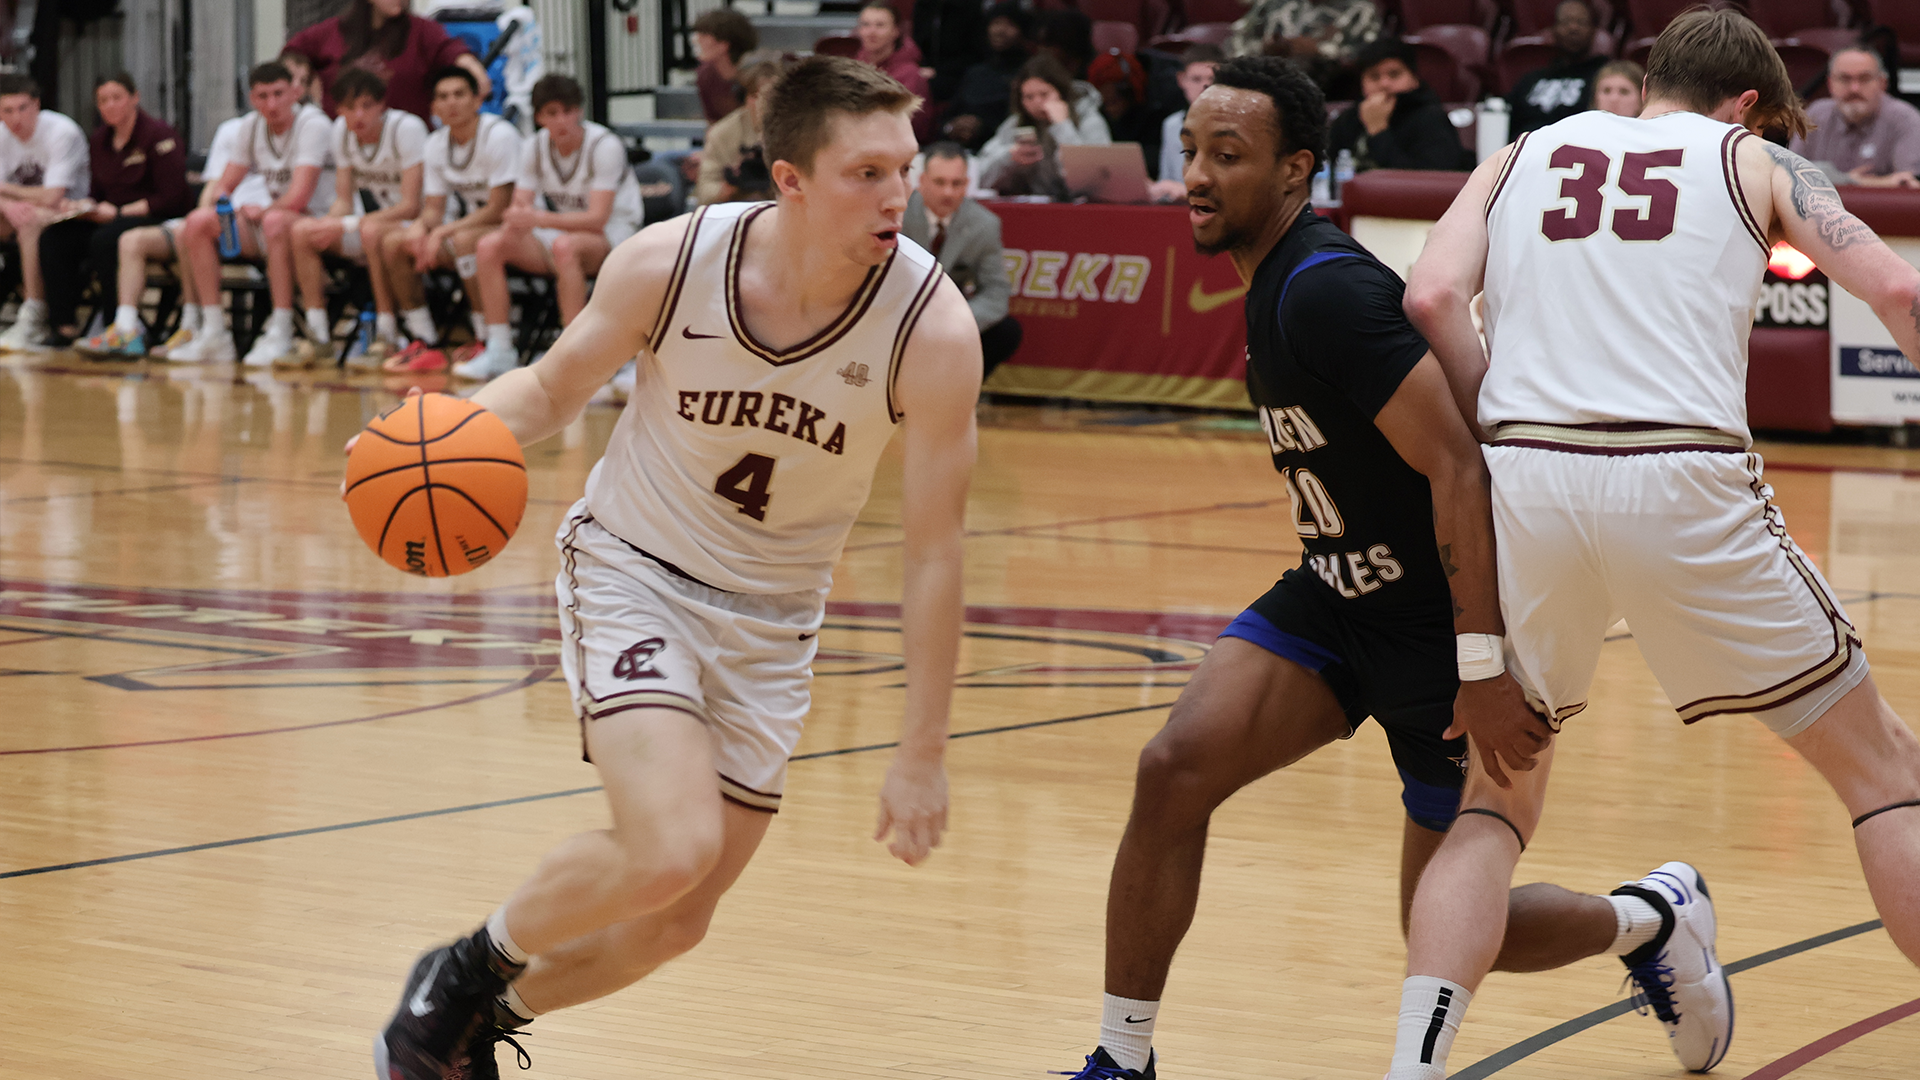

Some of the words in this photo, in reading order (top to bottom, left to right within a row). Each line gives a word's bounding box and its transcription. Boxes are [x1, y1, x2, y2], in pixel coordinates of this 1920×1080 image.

[1539, 142, 1687, 244] 35
[1755, 277, 1828, 325] POSS
[676, 389, 847, 456] EUREKA
[712, 451, 780, 524] 4
